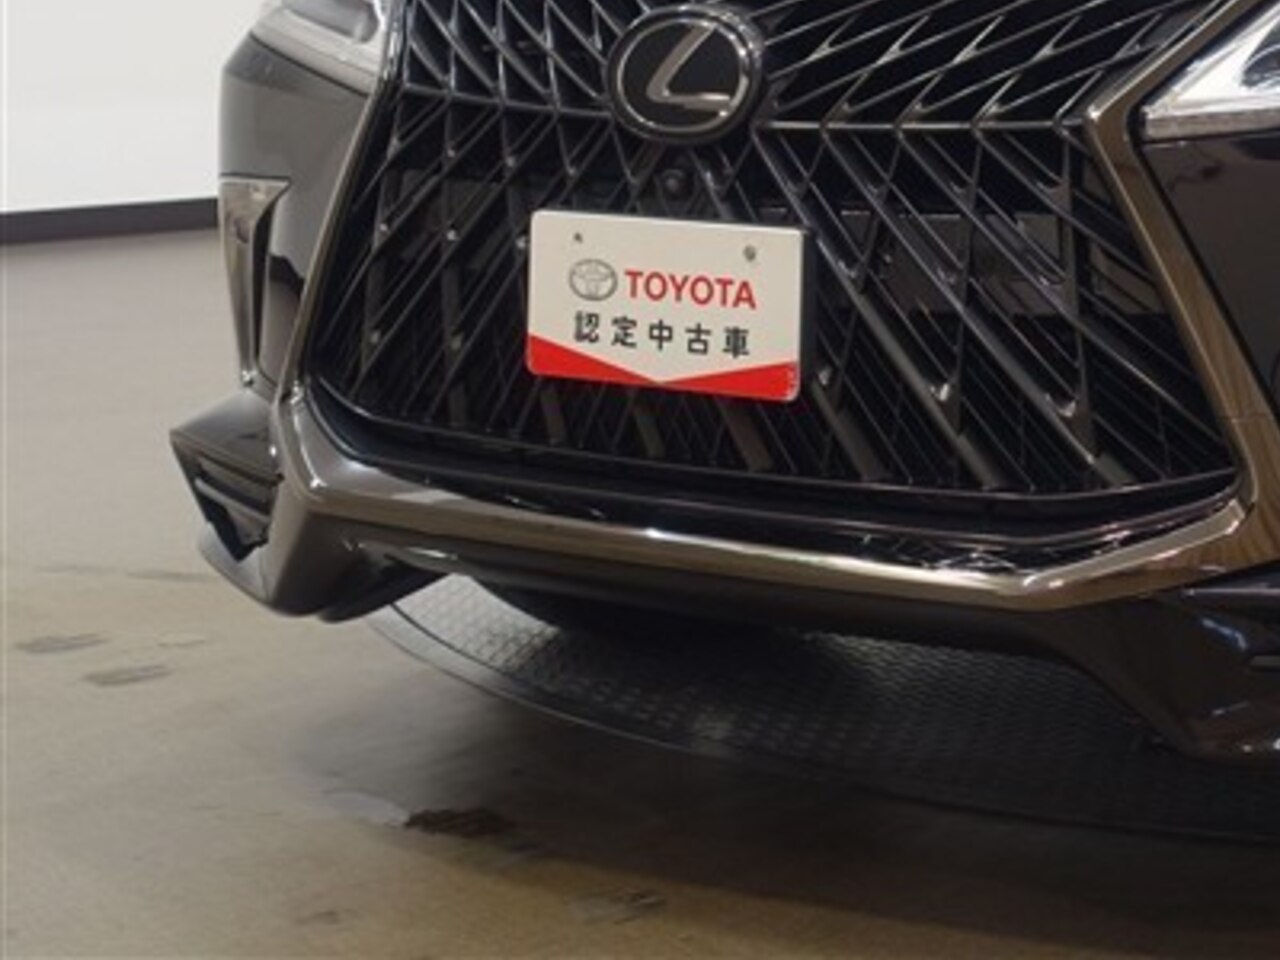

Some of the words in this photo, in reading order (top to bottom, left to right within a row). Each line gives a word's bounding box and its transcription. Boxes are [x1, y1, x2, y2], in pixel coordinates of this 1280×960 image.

[624, 269, 757, 309] TOYOTA
[573, 311, 750, 358] 認定中古車
